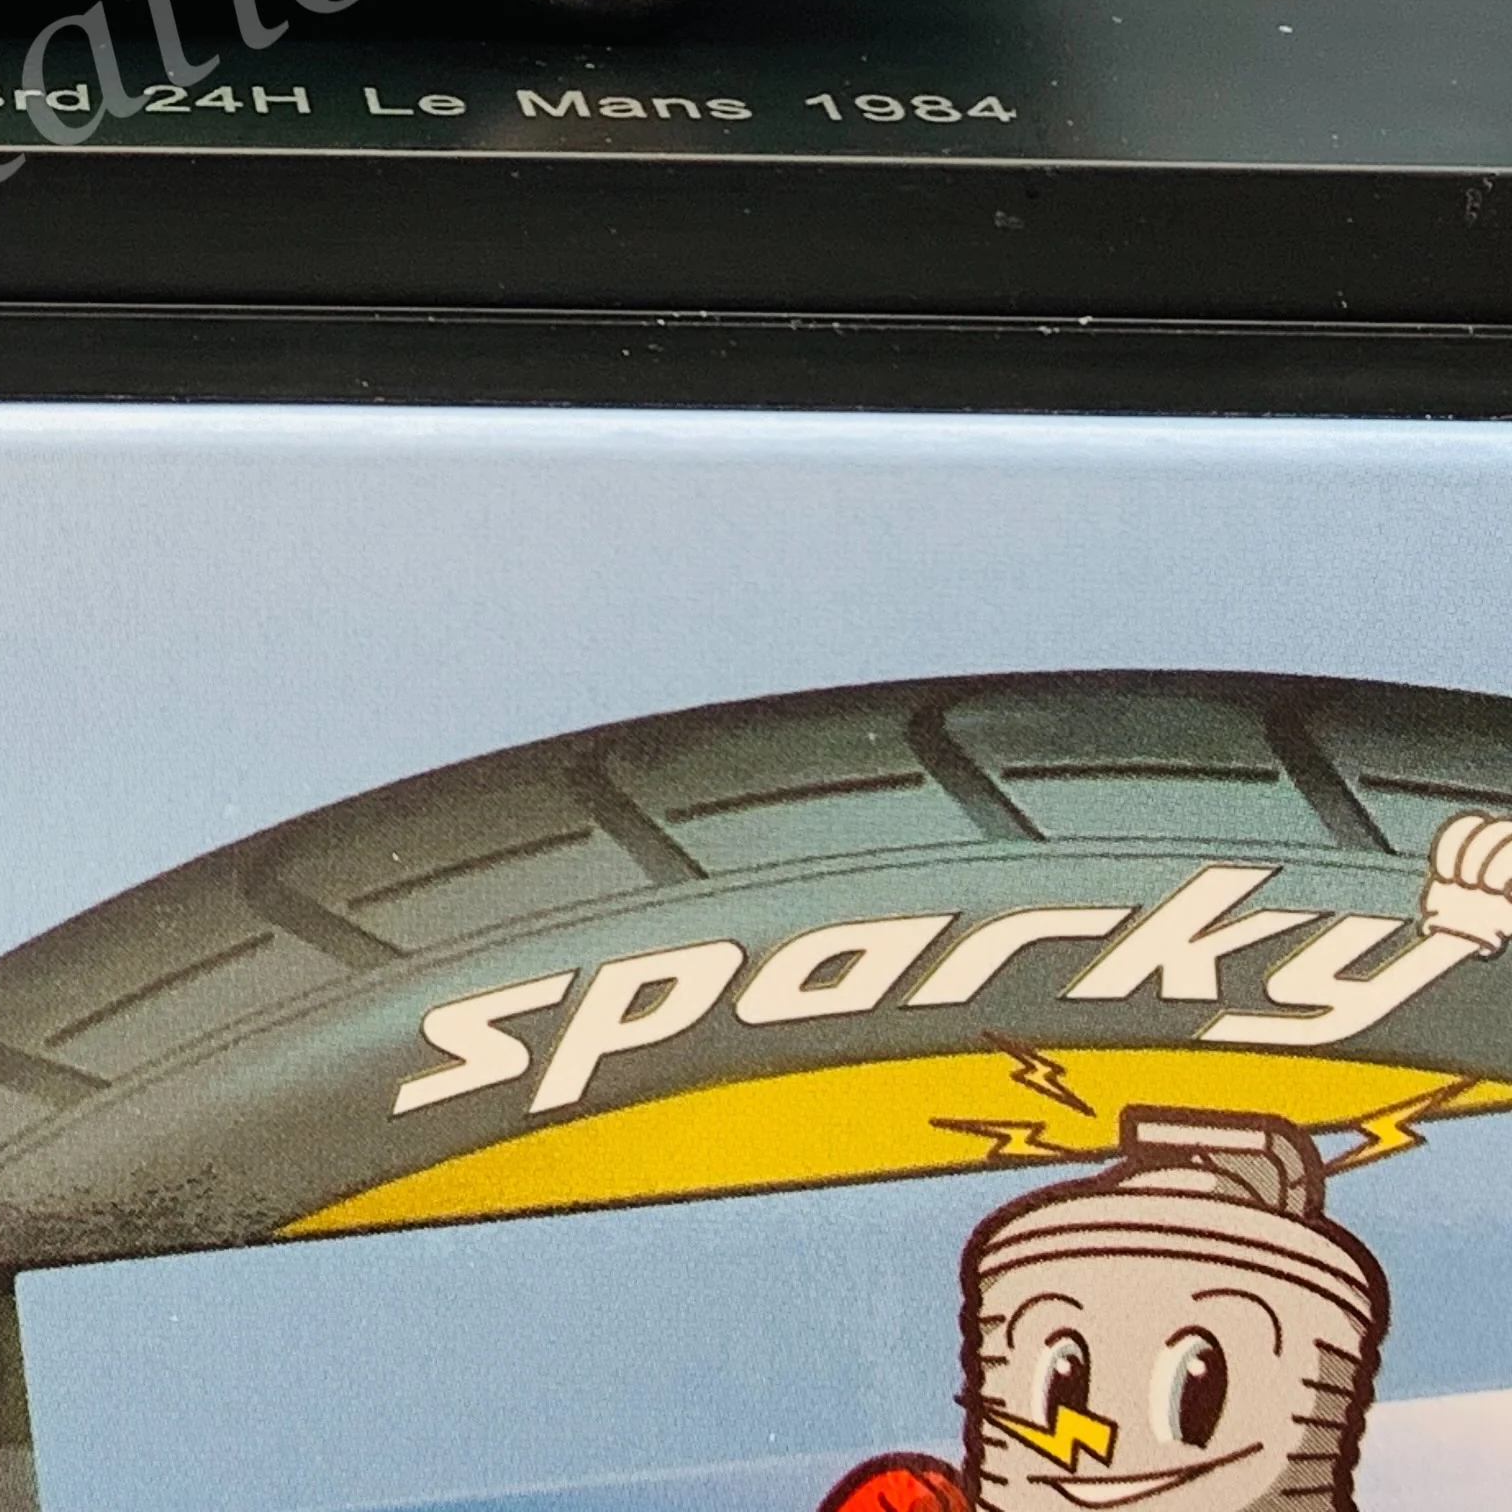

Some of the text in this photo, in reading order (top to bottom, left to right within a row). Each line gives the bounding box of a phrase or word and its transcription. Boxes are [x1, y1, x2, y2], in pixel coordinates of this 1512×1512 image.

[141, 84, 313, 114] 24H
[362, 86, 467, 117] Le
[515, 88, 754, 121] Mans
[803, 93, 1018, 124] 1984
[390, 864, 1478, 1116] sparky
